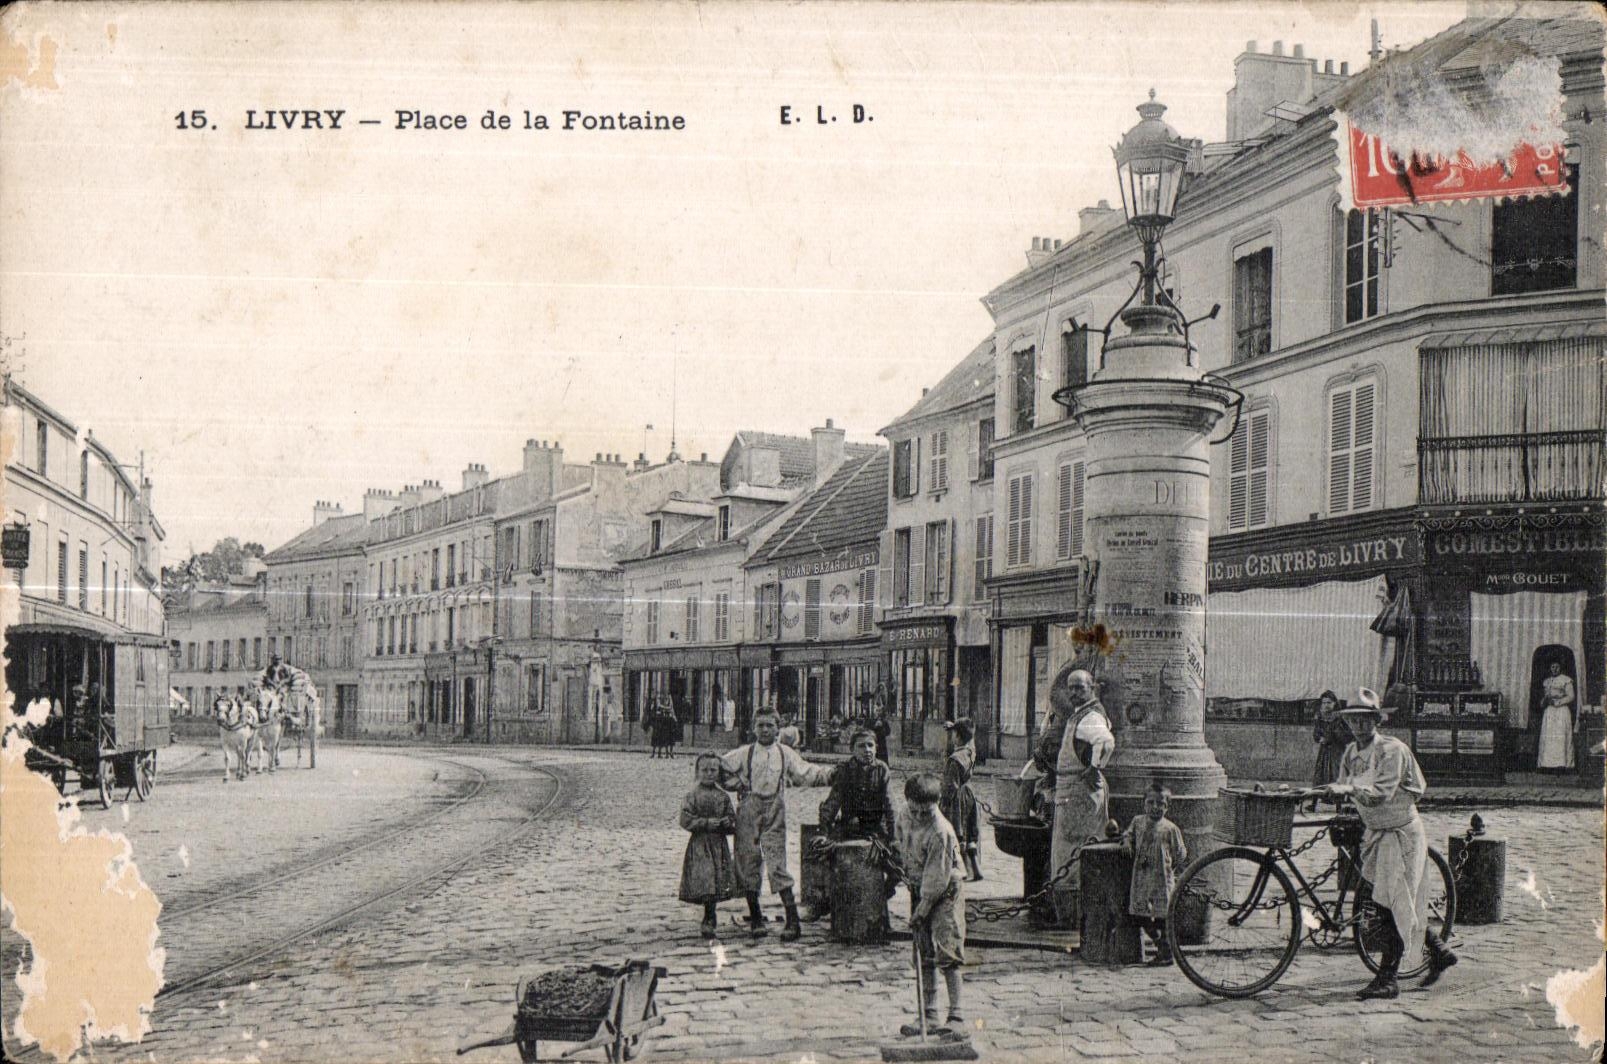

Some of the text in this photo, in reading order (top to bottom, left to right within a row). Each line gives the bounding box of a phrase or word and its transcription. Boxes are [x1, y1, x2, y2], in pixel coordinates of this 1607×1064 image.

[813, 560, 840, 574] BAZAR
[849, 551, 877, 568] LIVRY
[1225, 565, 1243, 579] DU
[1244, 550, 1317, 577] CENTRE
[1318, 552, 1337, 568] DE
[1338, 536, 1407, 566] LIVRY
[899, 626, 940, 640] RENARD
